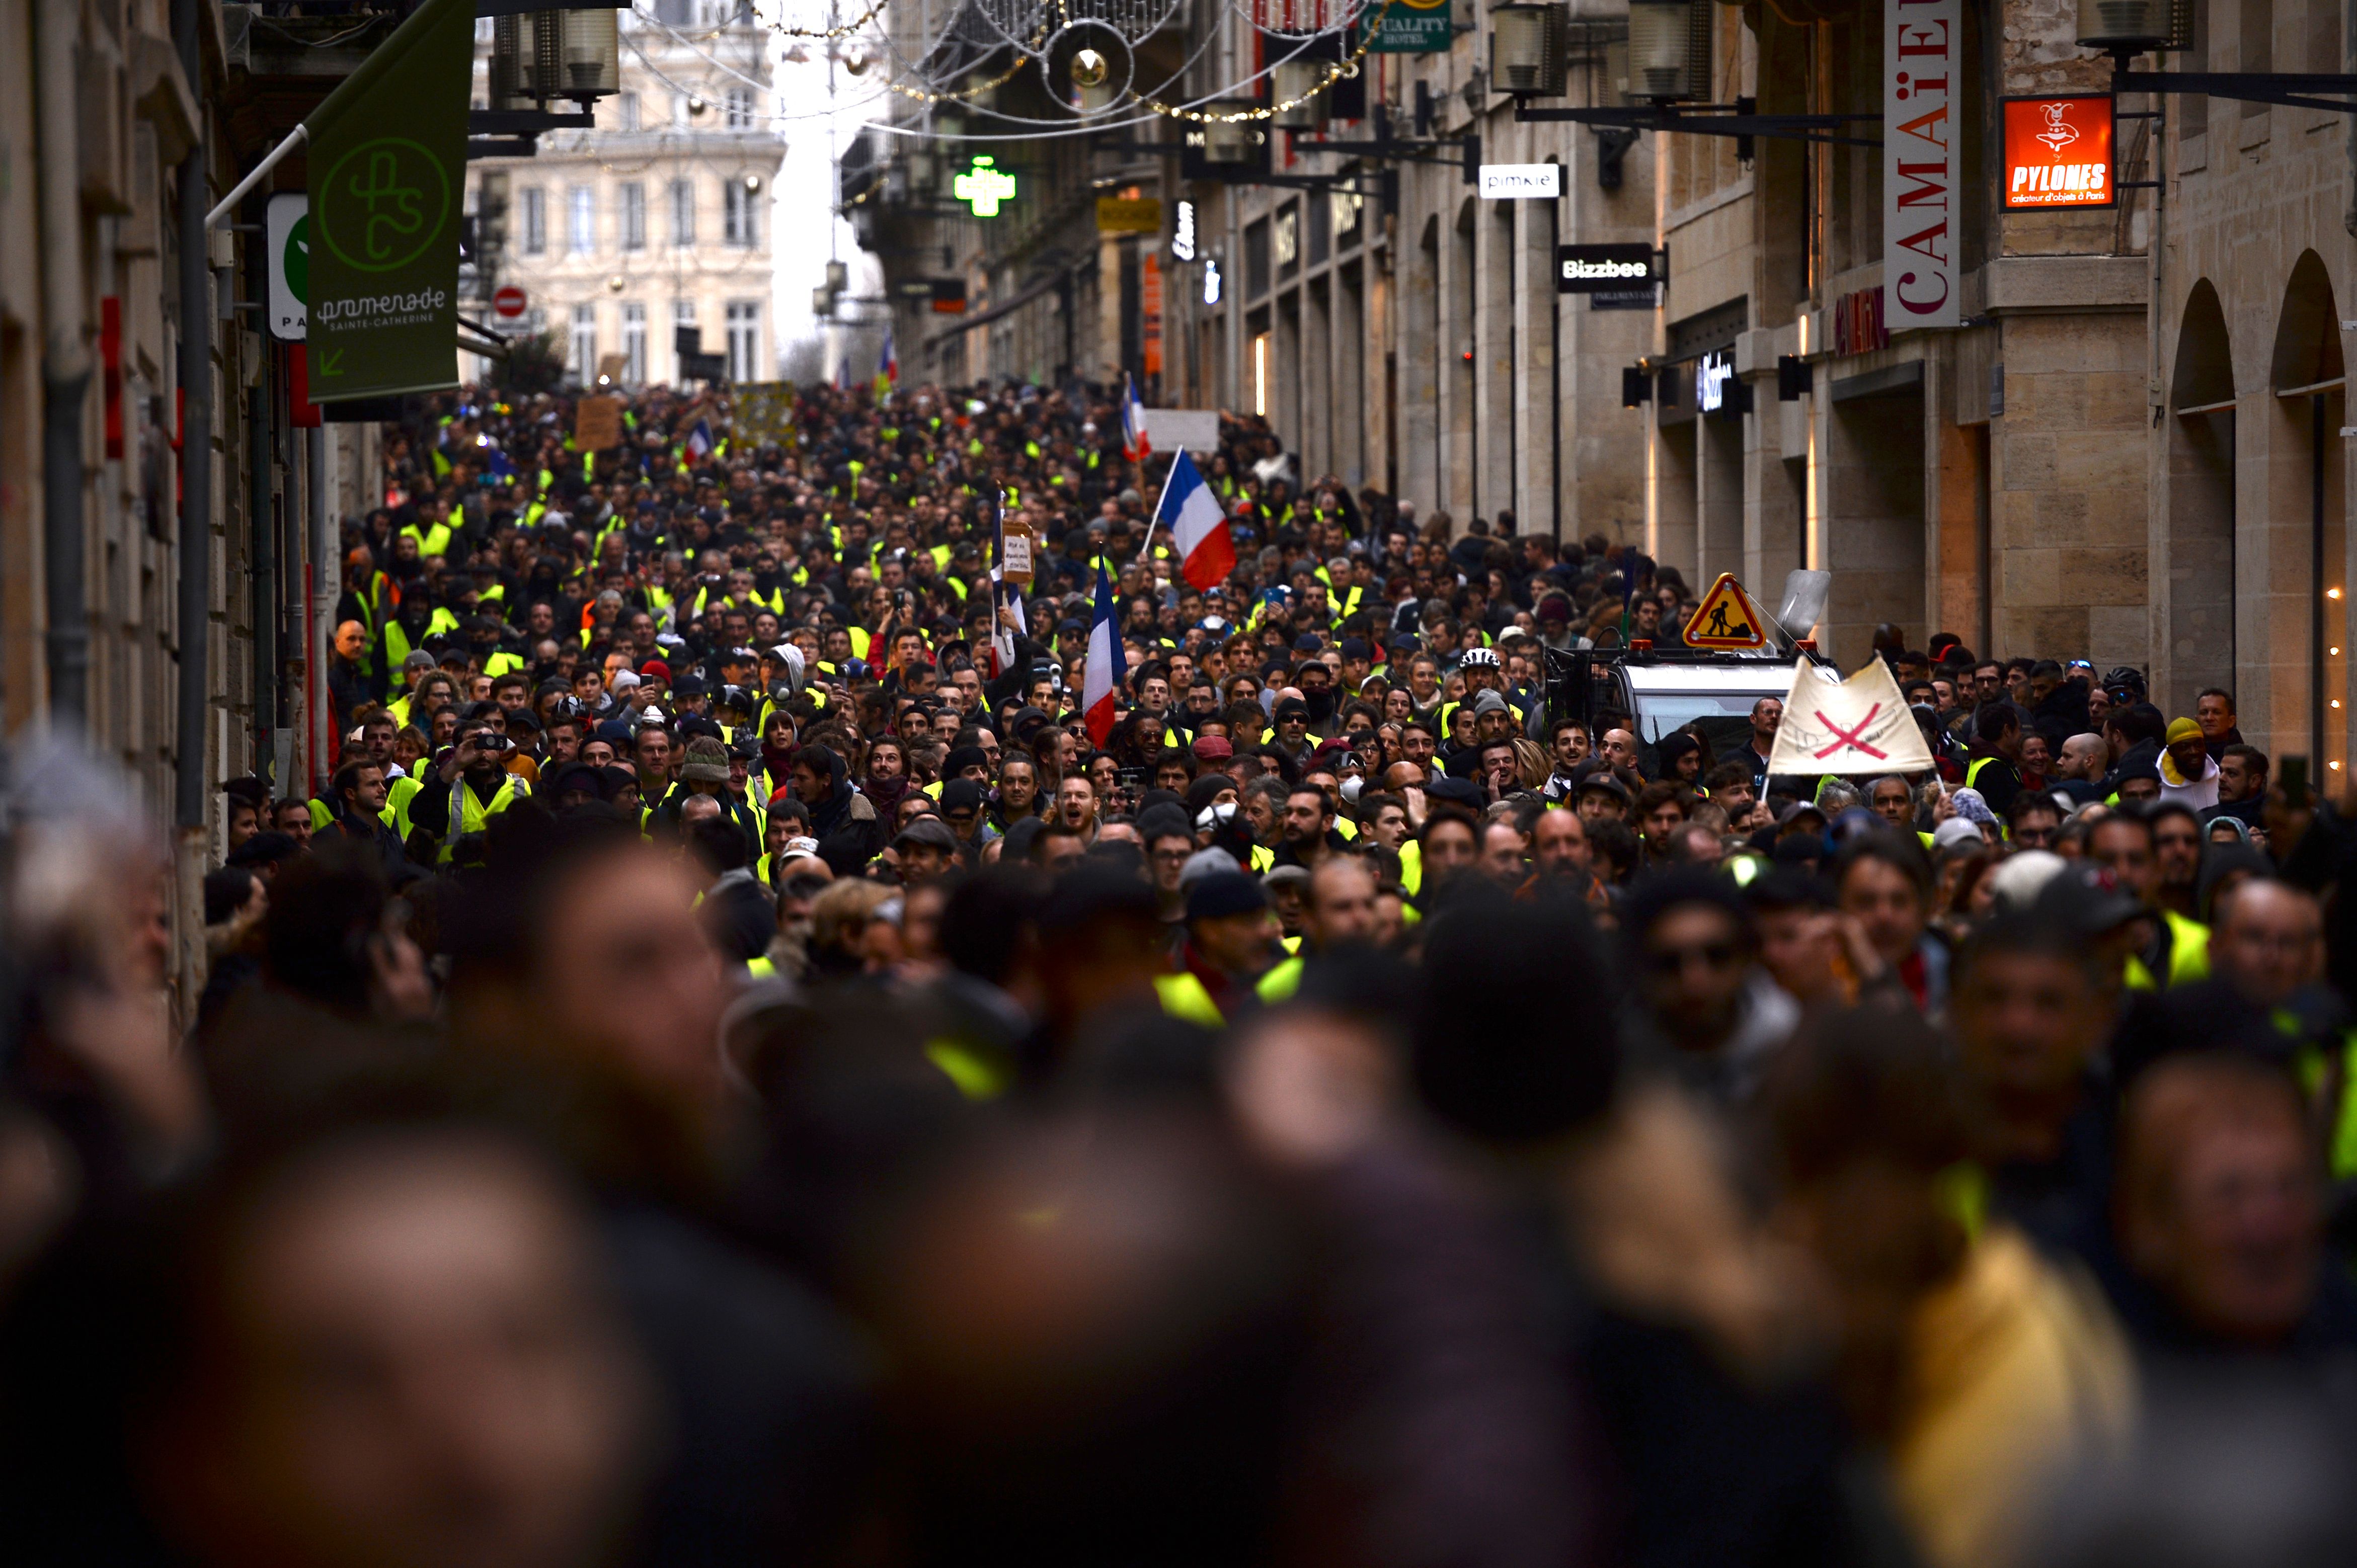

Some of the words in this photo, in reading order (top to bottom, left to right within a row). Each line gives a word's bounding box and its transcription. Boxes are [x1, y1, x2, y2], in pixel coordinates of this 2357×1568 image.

[1362, 12, 1447, 33] QUALITY
[1383, 33, 1428, 44] HOTEL
[2012, 163, 2106, 192] PYLONES
[2011, 194, 2044, 203] créateur
[2045, 192, 2077, 203] d'objets
[2078, 191, 2085, 201] à
[2086, 191, 2105, 200] Paris
[1562, 258, 1647, 278] Bizzbee
[317, 286, 445, 324] promenade
[330, 312, 434, 332] SAINTE-CATHERINE
